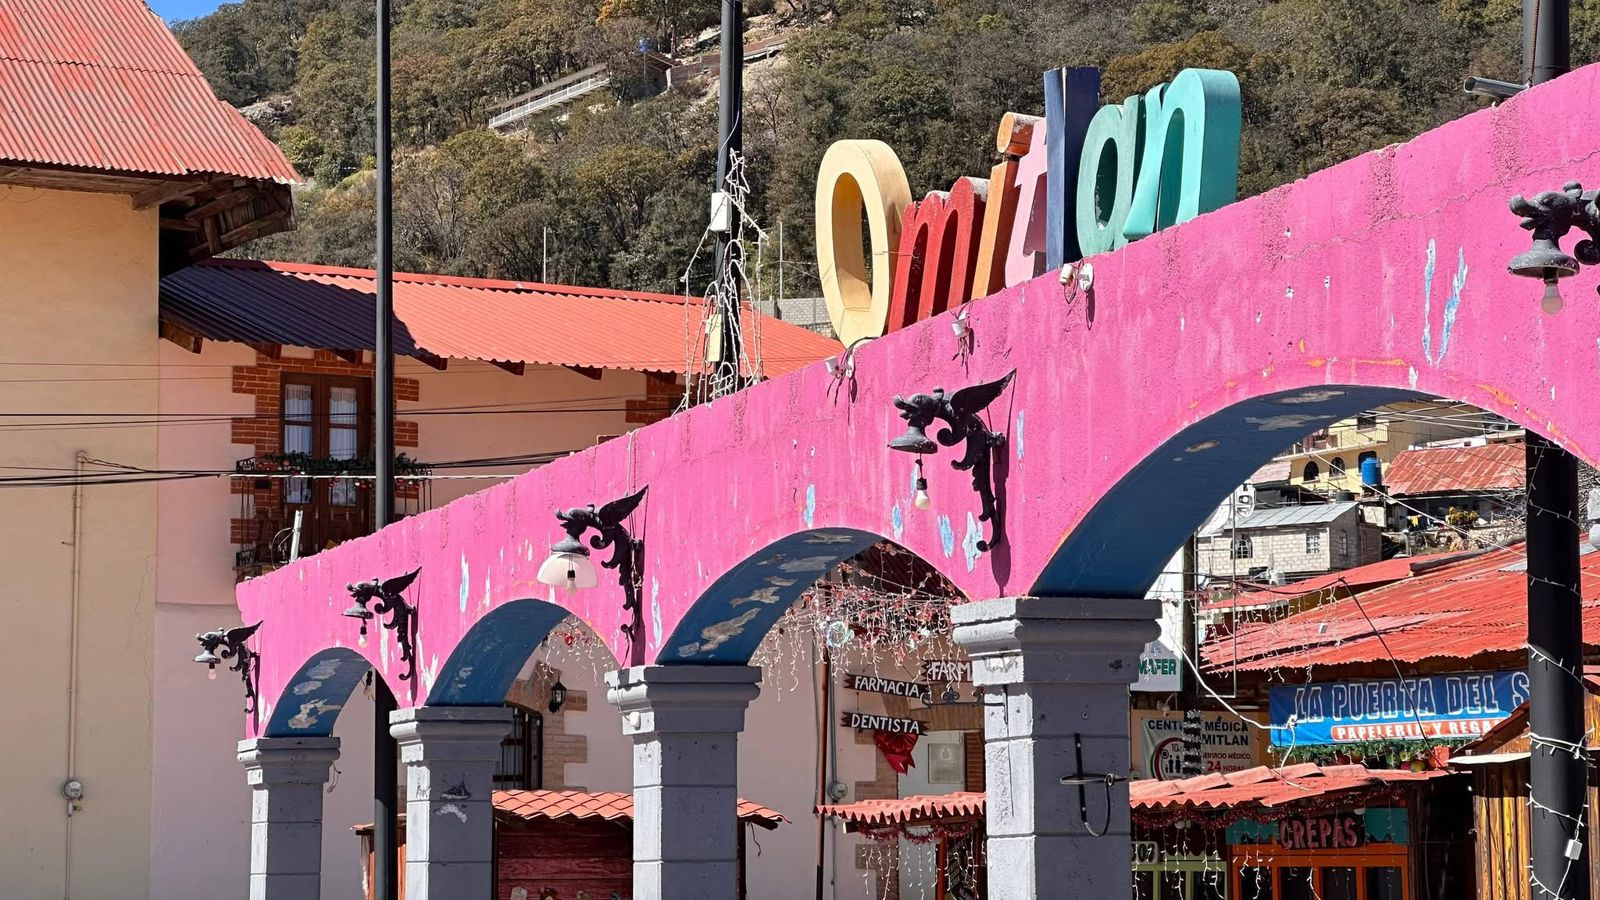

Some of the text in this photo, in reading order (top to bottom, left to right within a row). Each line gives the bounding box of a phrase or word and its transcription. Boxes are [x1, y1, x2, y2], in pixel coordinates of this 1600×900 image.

[815, 67, 1241, 348] Omitlan
[931, 661, 973, 682] FARM
[854, 676, 920, 697] FARMACIA
[1295, 671, 1530, 723] LA PUERTA DEL S
[850, 713, 920, 734] DENTISTA
[1205, 715, 1249, 732] MÉDICA
[1336, 723, 1425, 740] PAPELERIA
[1431, 722, 1442, 735] Y
[1207, 761, 1222, 772] 24
[1280, 817, 1357, 849] CREPAS
